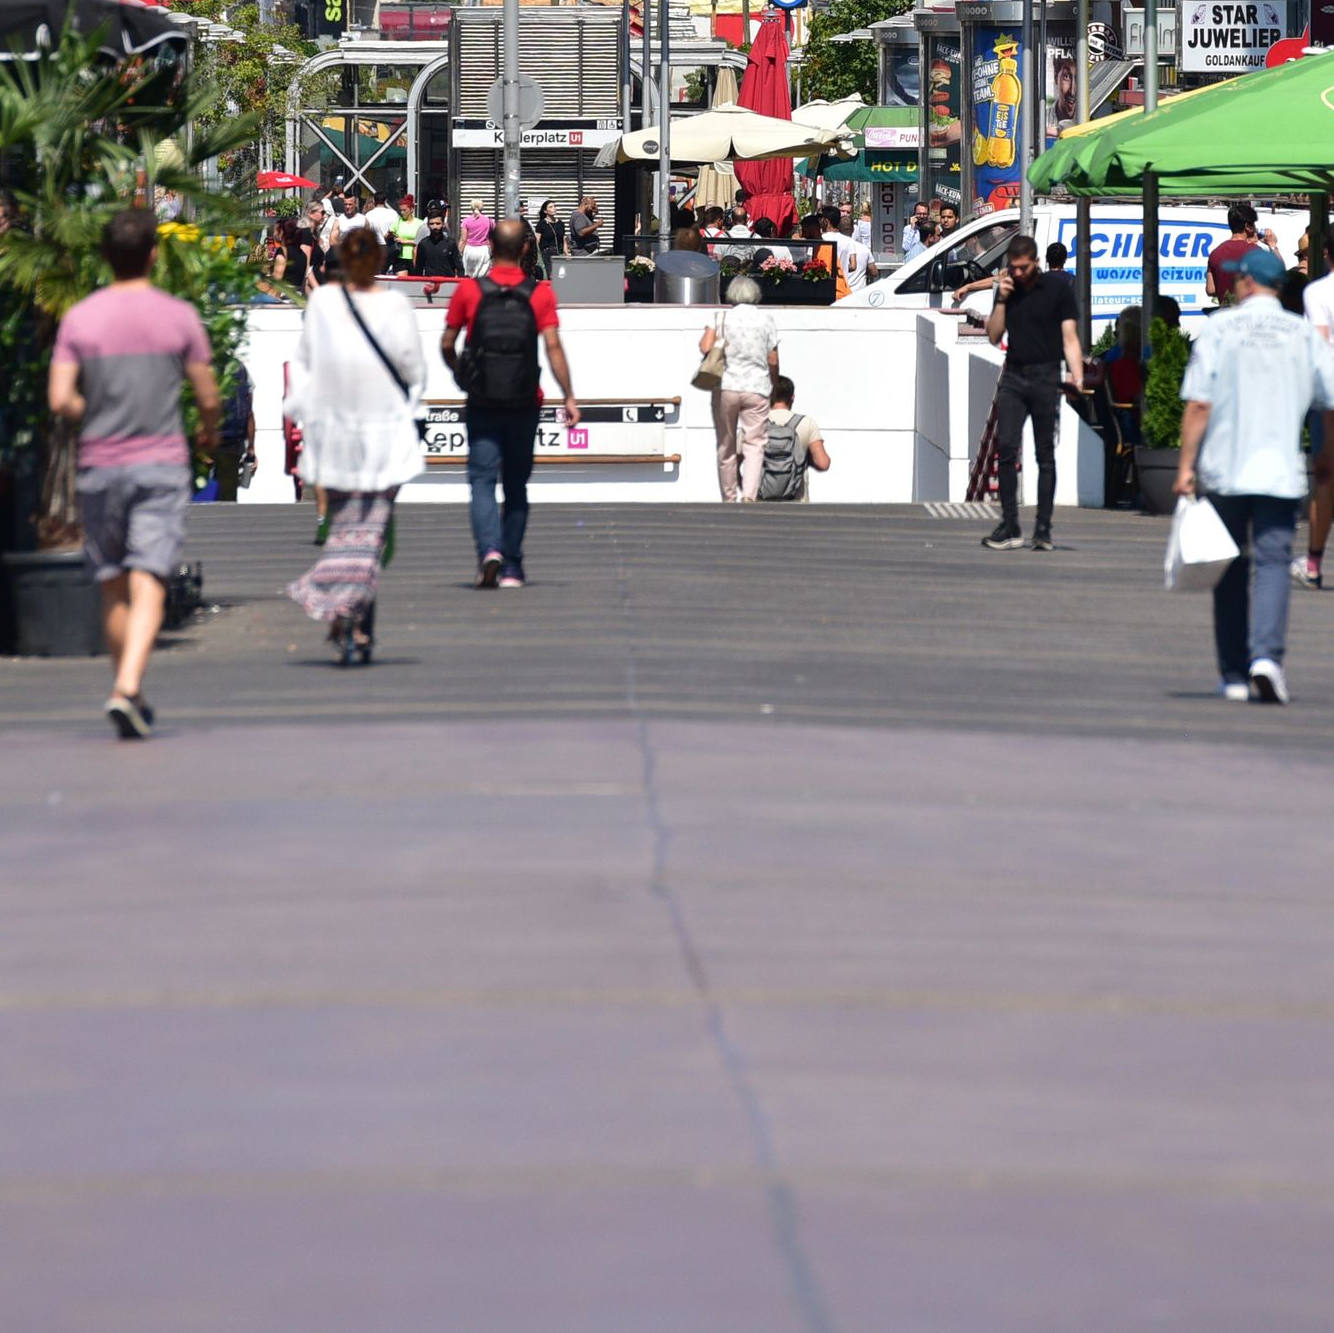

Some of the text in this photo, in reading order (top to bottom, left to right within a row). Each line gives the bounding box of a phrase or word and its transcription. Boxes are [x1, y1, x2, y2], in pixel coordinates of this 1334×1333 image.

[1212, 4, 1259, 25] STAR
[1130, 22, 1176, 45] Film
[1188, 28, 1282, 49] JUWELIER
[1205, 54, 1266, 68] GOLDANKAUF
[494, 130, 582, 147] Klerplatz U1
[870, 160, 902, 172] HOT
[1096, 266, 1208, 280] wasse eizun
[570, 431, 585, 445] U1
